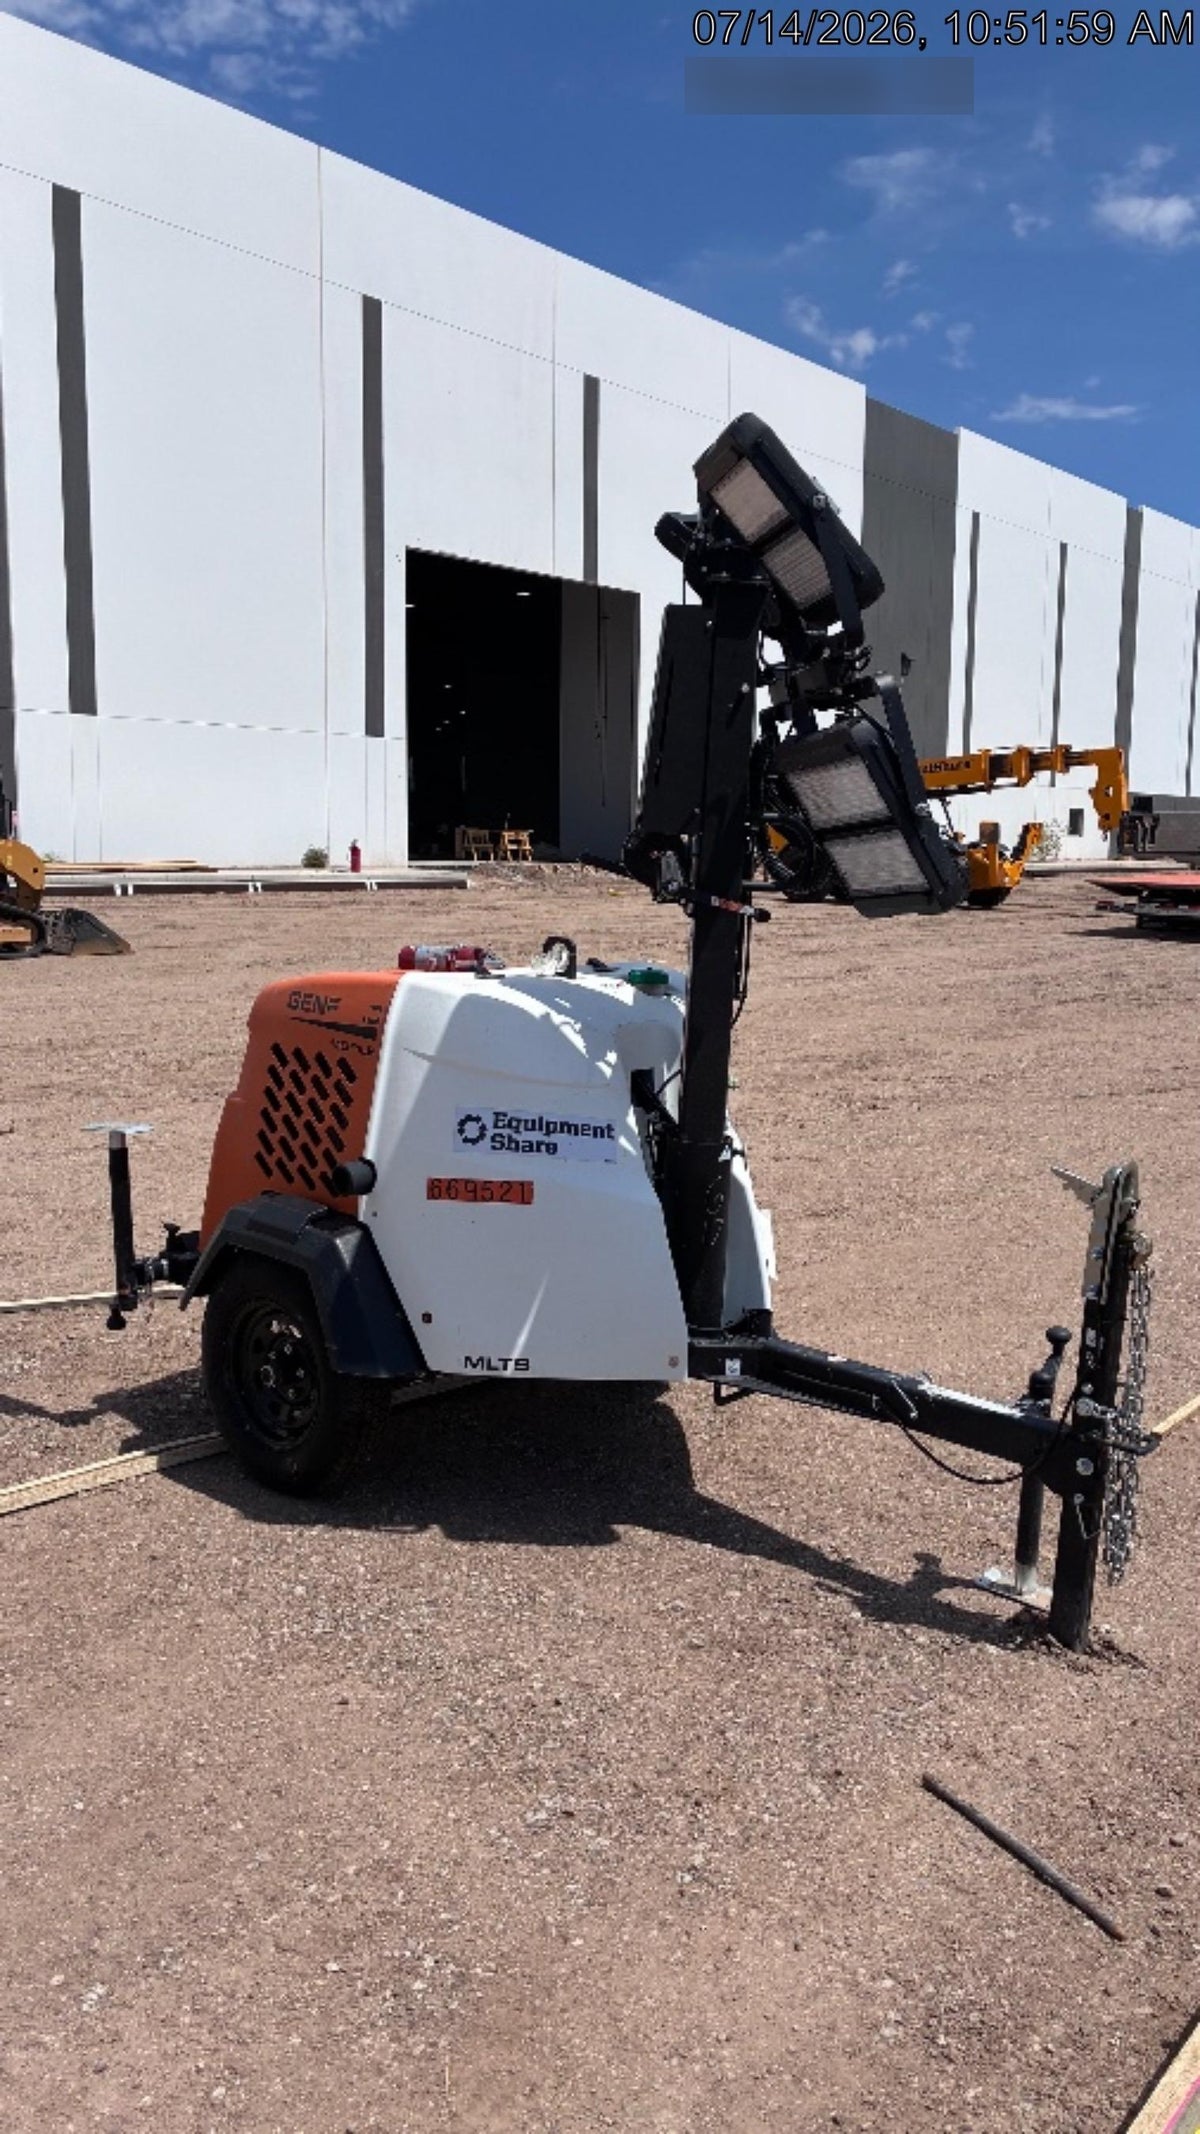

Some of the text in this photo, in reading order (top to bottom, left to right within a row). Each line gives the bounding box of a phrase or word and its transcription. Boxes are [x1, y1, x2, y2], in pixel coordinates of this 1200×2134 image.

[493, 1111, 616, 1140] Equipment
[490, 1133, 558, 1155] Share
[431, 1177, 526, 1203] 669521
